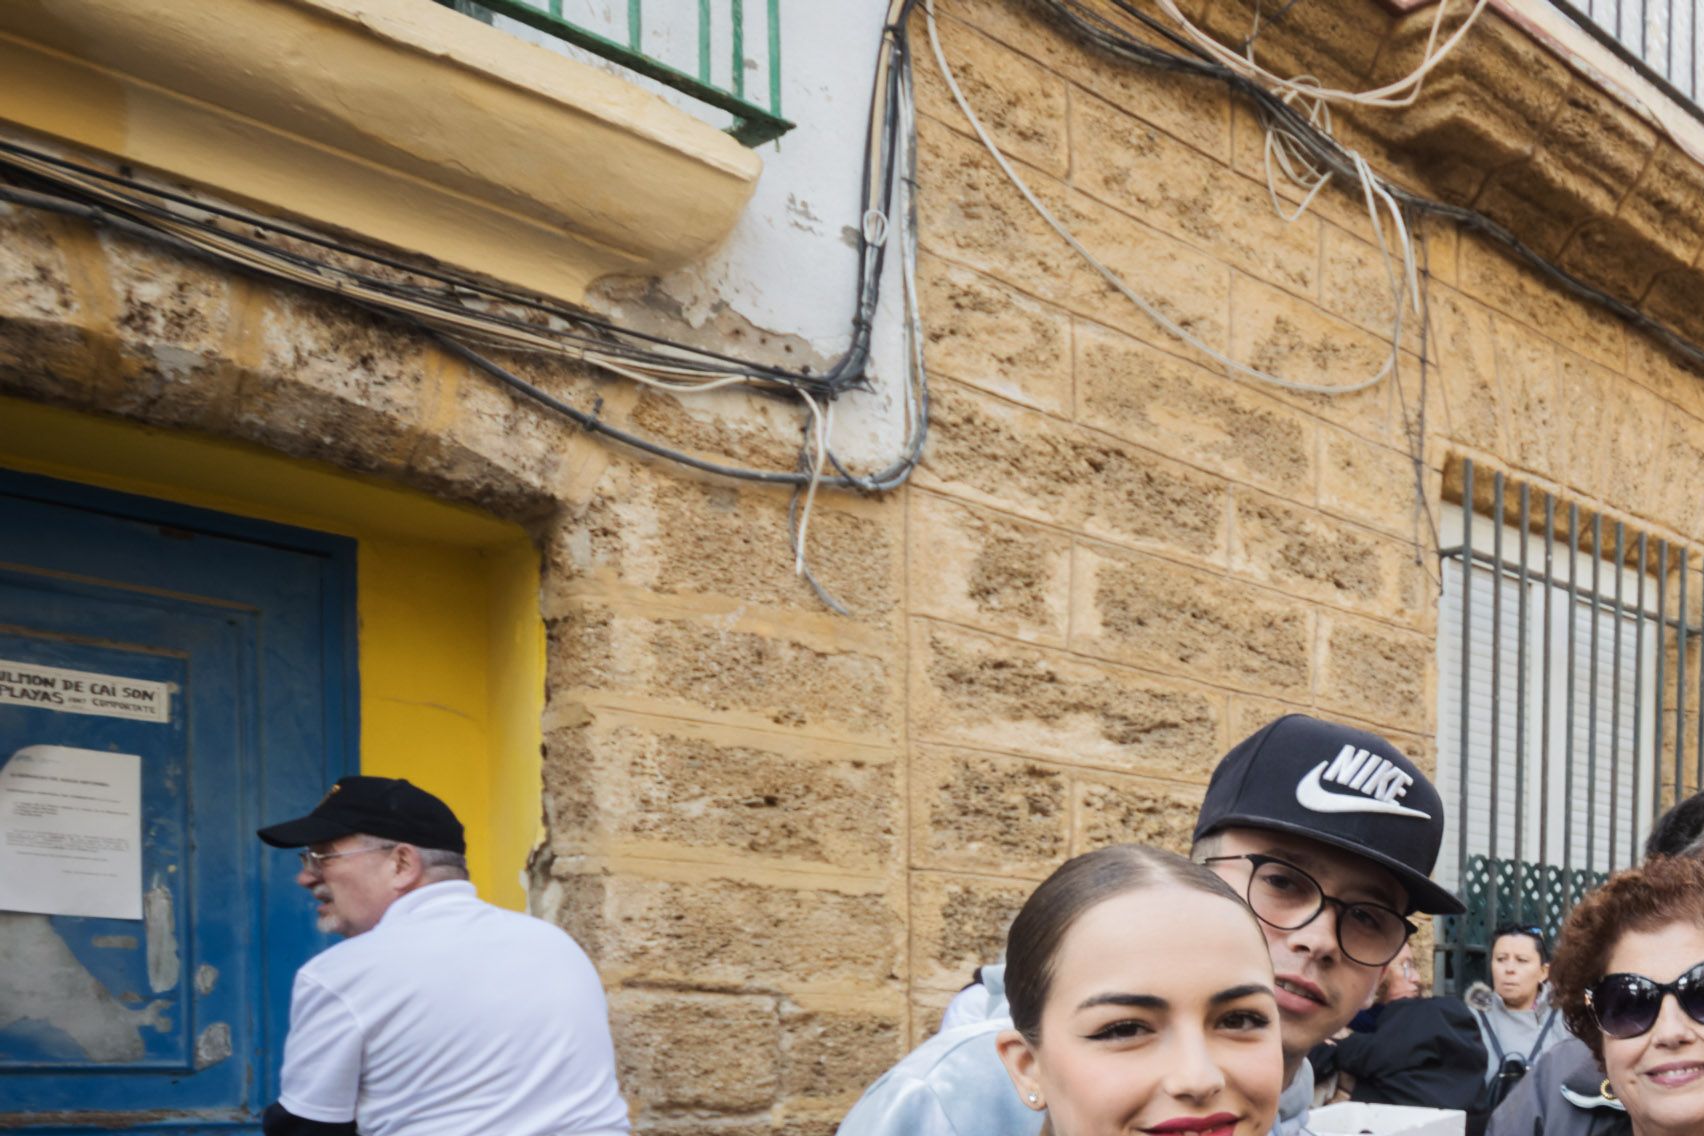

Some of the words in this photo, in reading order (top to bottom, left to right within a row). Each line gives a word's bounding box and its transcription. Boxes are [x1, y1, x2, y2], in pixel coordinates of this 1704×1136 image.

[62, 679, 84, 693] DE
[122, 687, 155, 701] SON
[1323, 744, 1414, 807] NIKE
